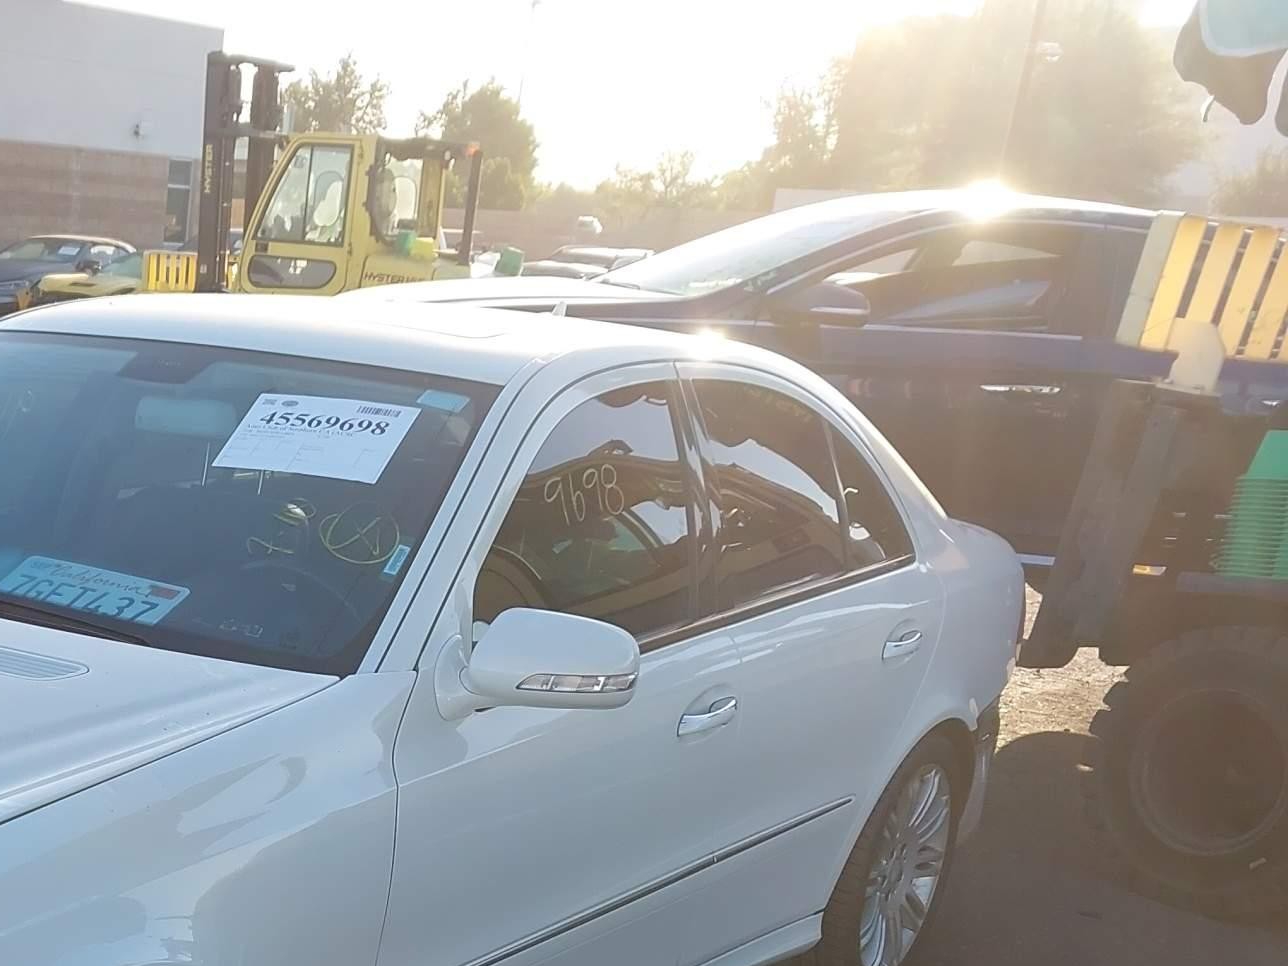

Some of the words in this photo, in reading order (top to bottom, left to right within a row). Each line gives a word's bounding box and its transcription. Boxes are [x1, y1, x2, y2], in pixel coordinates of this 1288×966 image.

[203, 143, 214, 193] HYSTER
[259, 410, 391, 436] 45569698
[543, 463, 625, 526] 9698
